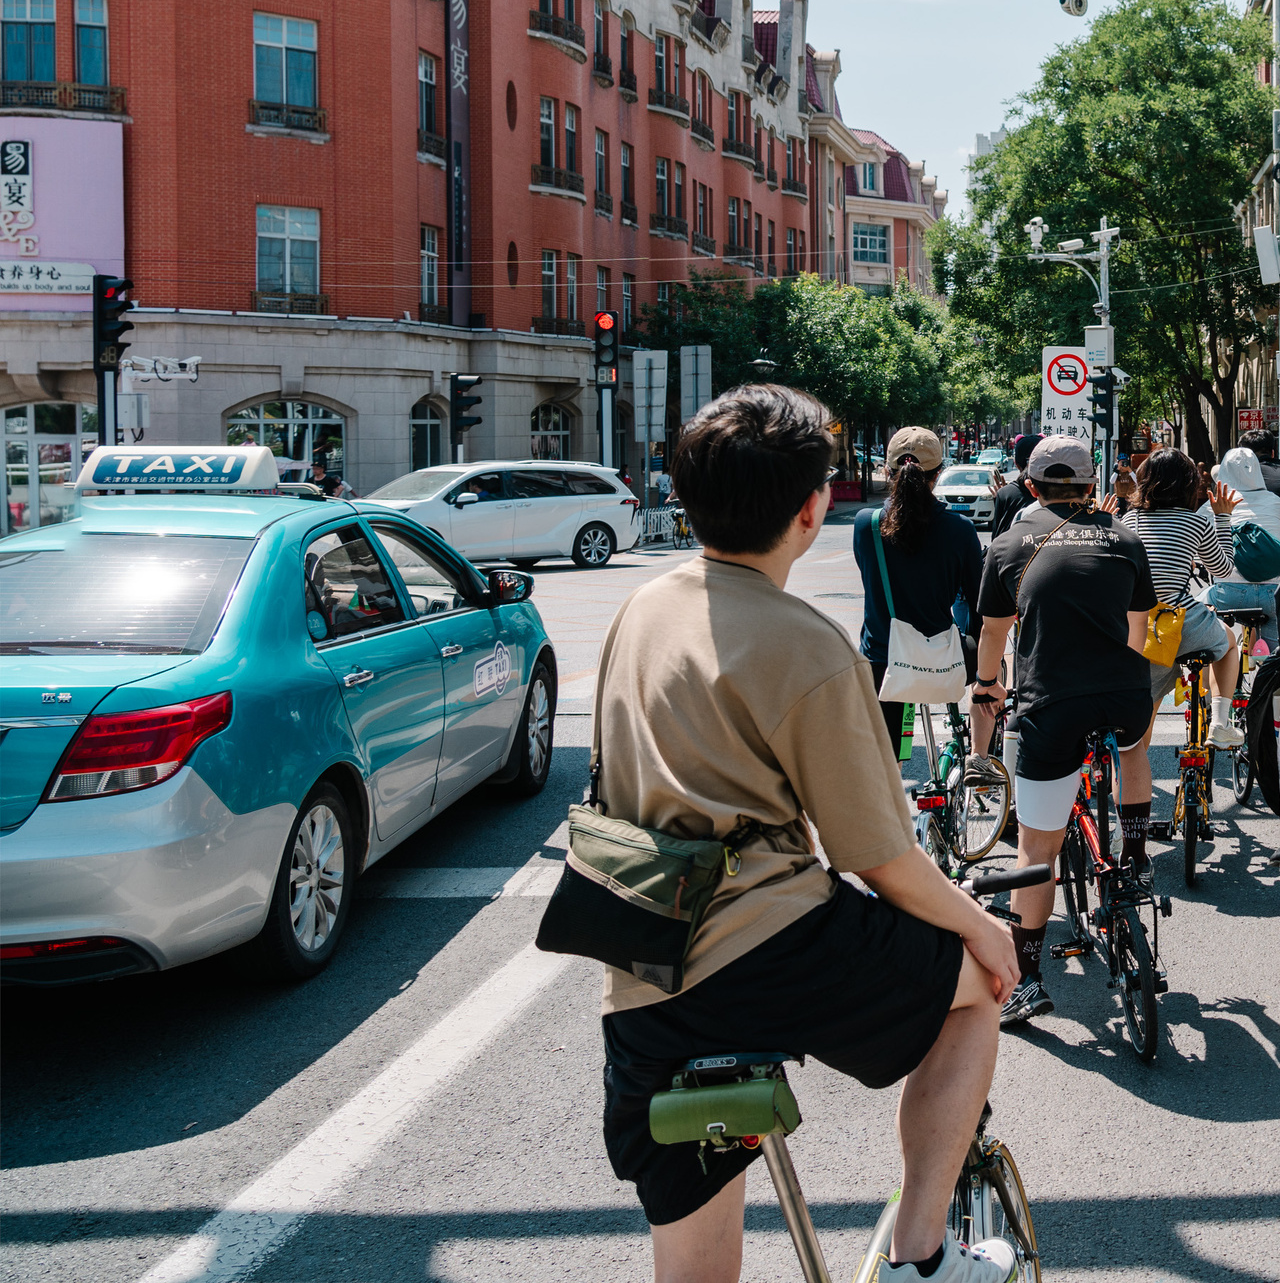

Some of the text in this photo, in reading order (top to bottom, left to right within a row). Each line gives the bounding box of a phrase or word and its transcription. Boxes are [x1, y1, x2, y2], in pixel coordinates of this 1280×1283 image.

[4, 142, 27, 207] 易宴
[22, 284, 32, 292] up
[34, 283, 54, 292] body
[57, 283, 72, 291] and
[1046, 407, 1088, 421] 机动车
[1043, 425, 1090, 439] 禁止驶入
[113, 455, 237, 474] TAXI
[893, 661, 911, 669] KEEP
[911, 665, 935, 674] WAVE,
